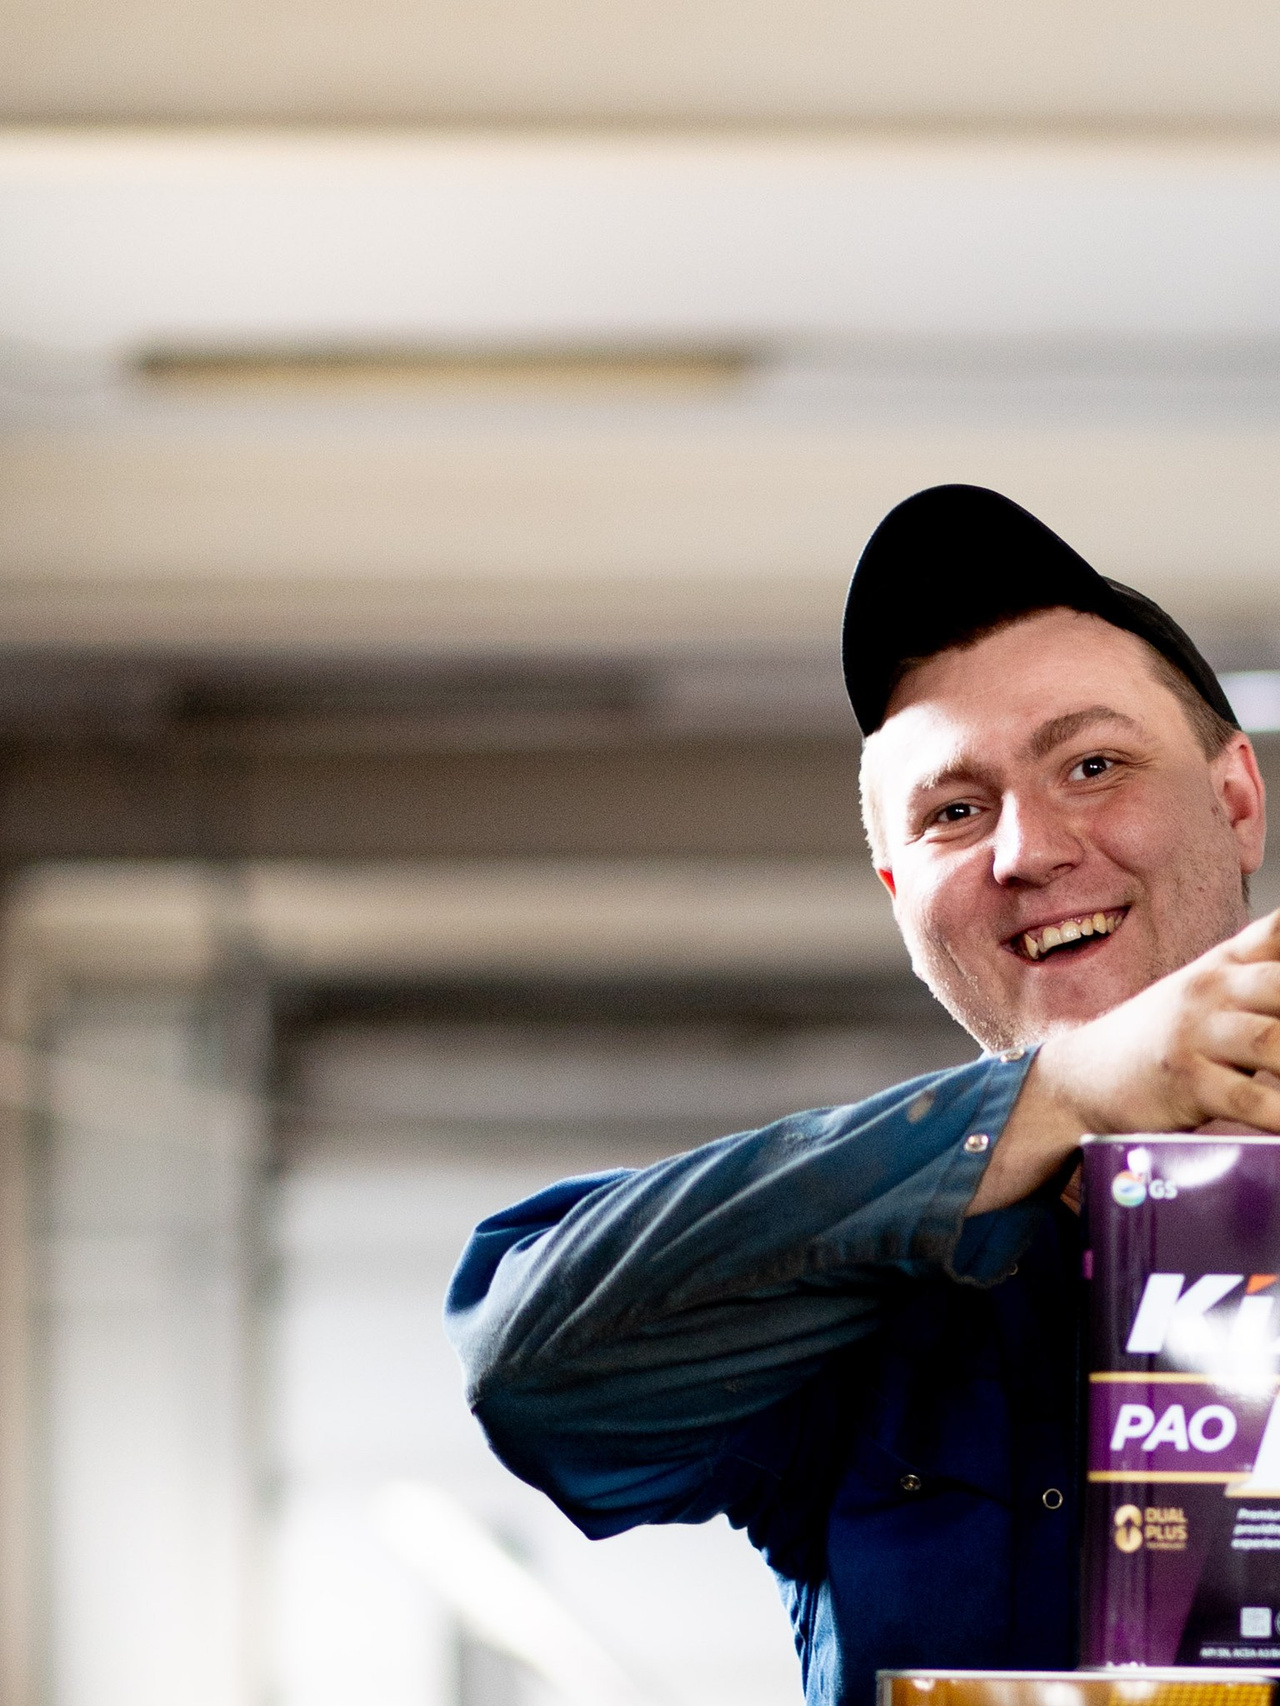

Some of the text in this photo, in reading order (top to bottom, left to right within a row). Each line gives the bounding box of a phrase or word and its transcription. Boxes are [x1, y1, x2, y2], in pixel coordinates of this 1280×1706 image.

[1149, 1181, 1178, 1199] GS
[1110, 1404, 1237, 1452] PAO
[1145, 1508, 1186, 1522] DUAL
[1145, 1525, 1187, 1540] PLUS
